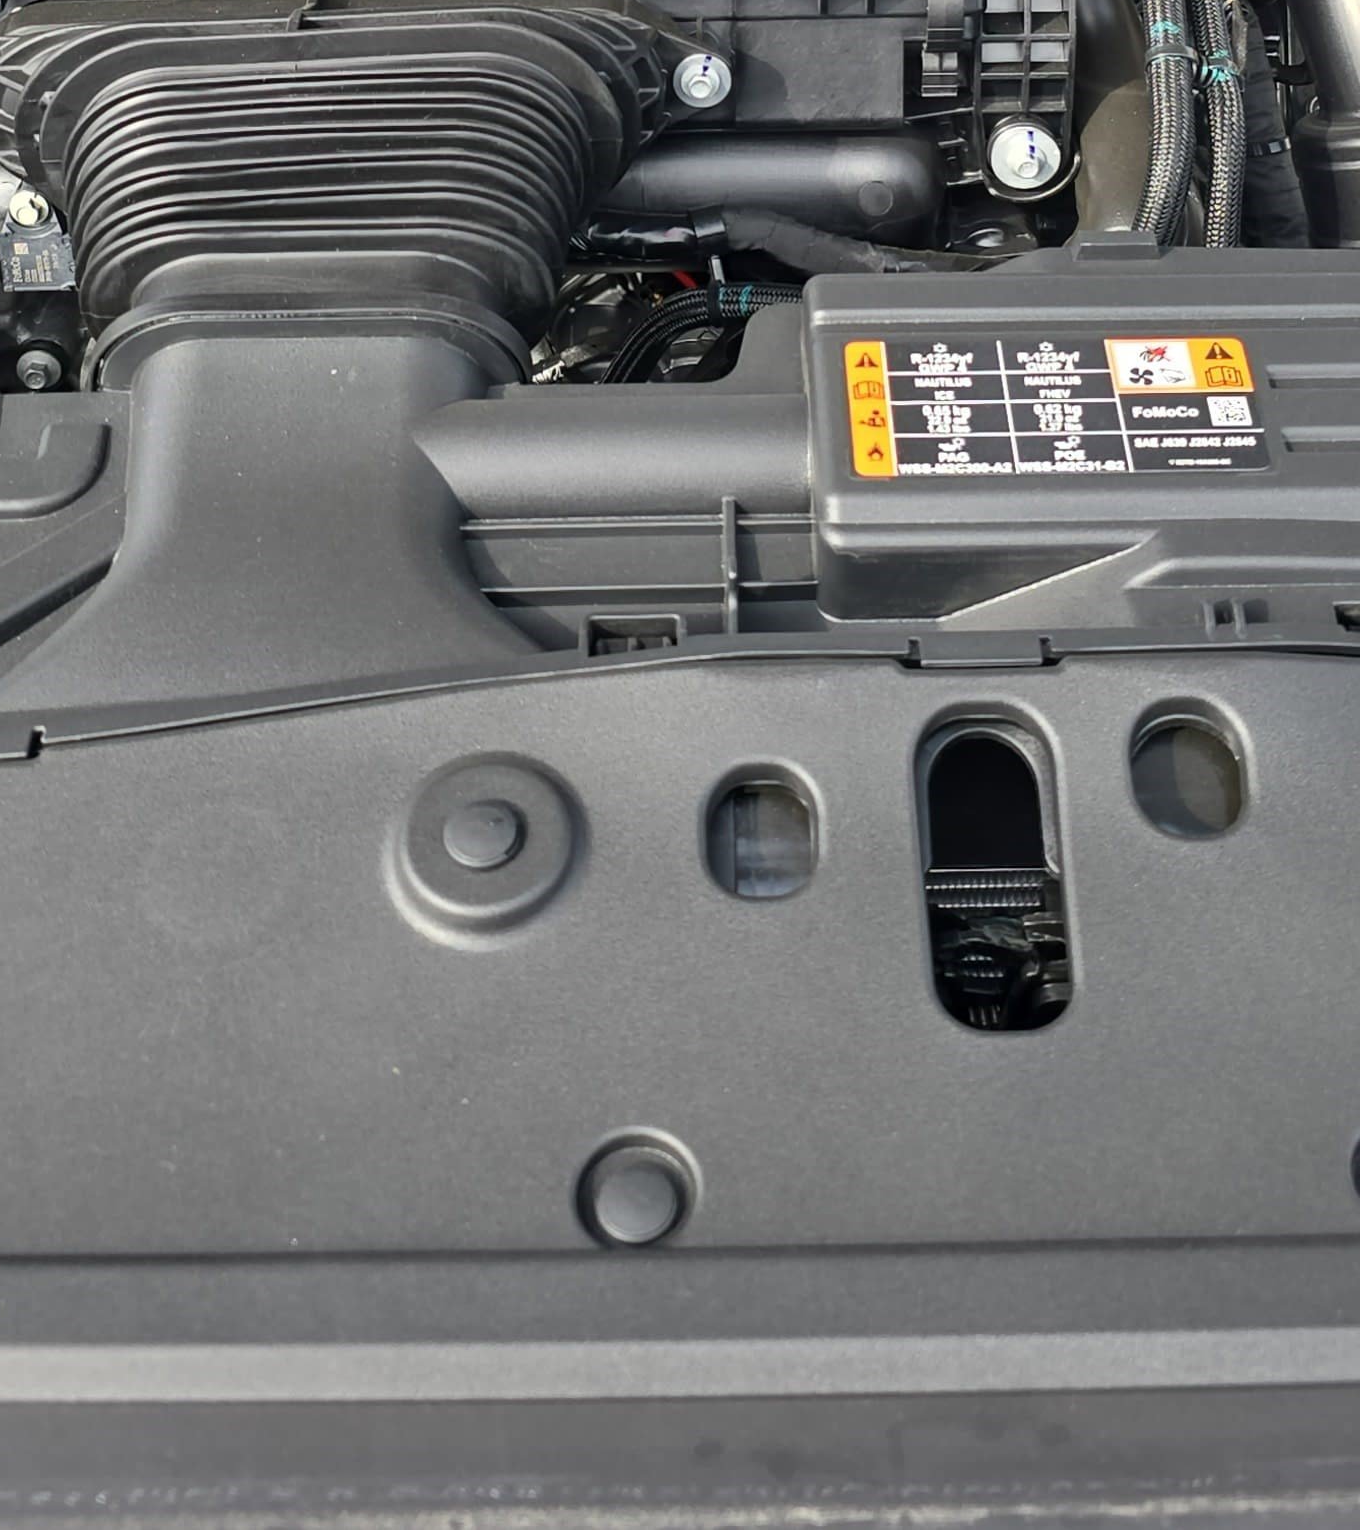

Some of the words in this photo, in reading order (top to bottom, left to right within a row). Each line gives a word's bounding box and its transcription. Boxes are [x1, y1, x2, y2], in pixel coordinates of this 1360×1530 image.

[914, 376, 973, 387] NAUTILUS
[1024, 375, 1082, 385] NAUTILUS
[1039, 389, 1071, 398] FHEV
[953, 405, 971, 419] kg
[1064, 403, 1083, 417] kg
[1131, 406, 1199, 418] FoMoCo
[1133, 437, 1159, 448] SAE
[938, 452, 970, 462] PAG
[1054, 450, 1085, 460] POE
